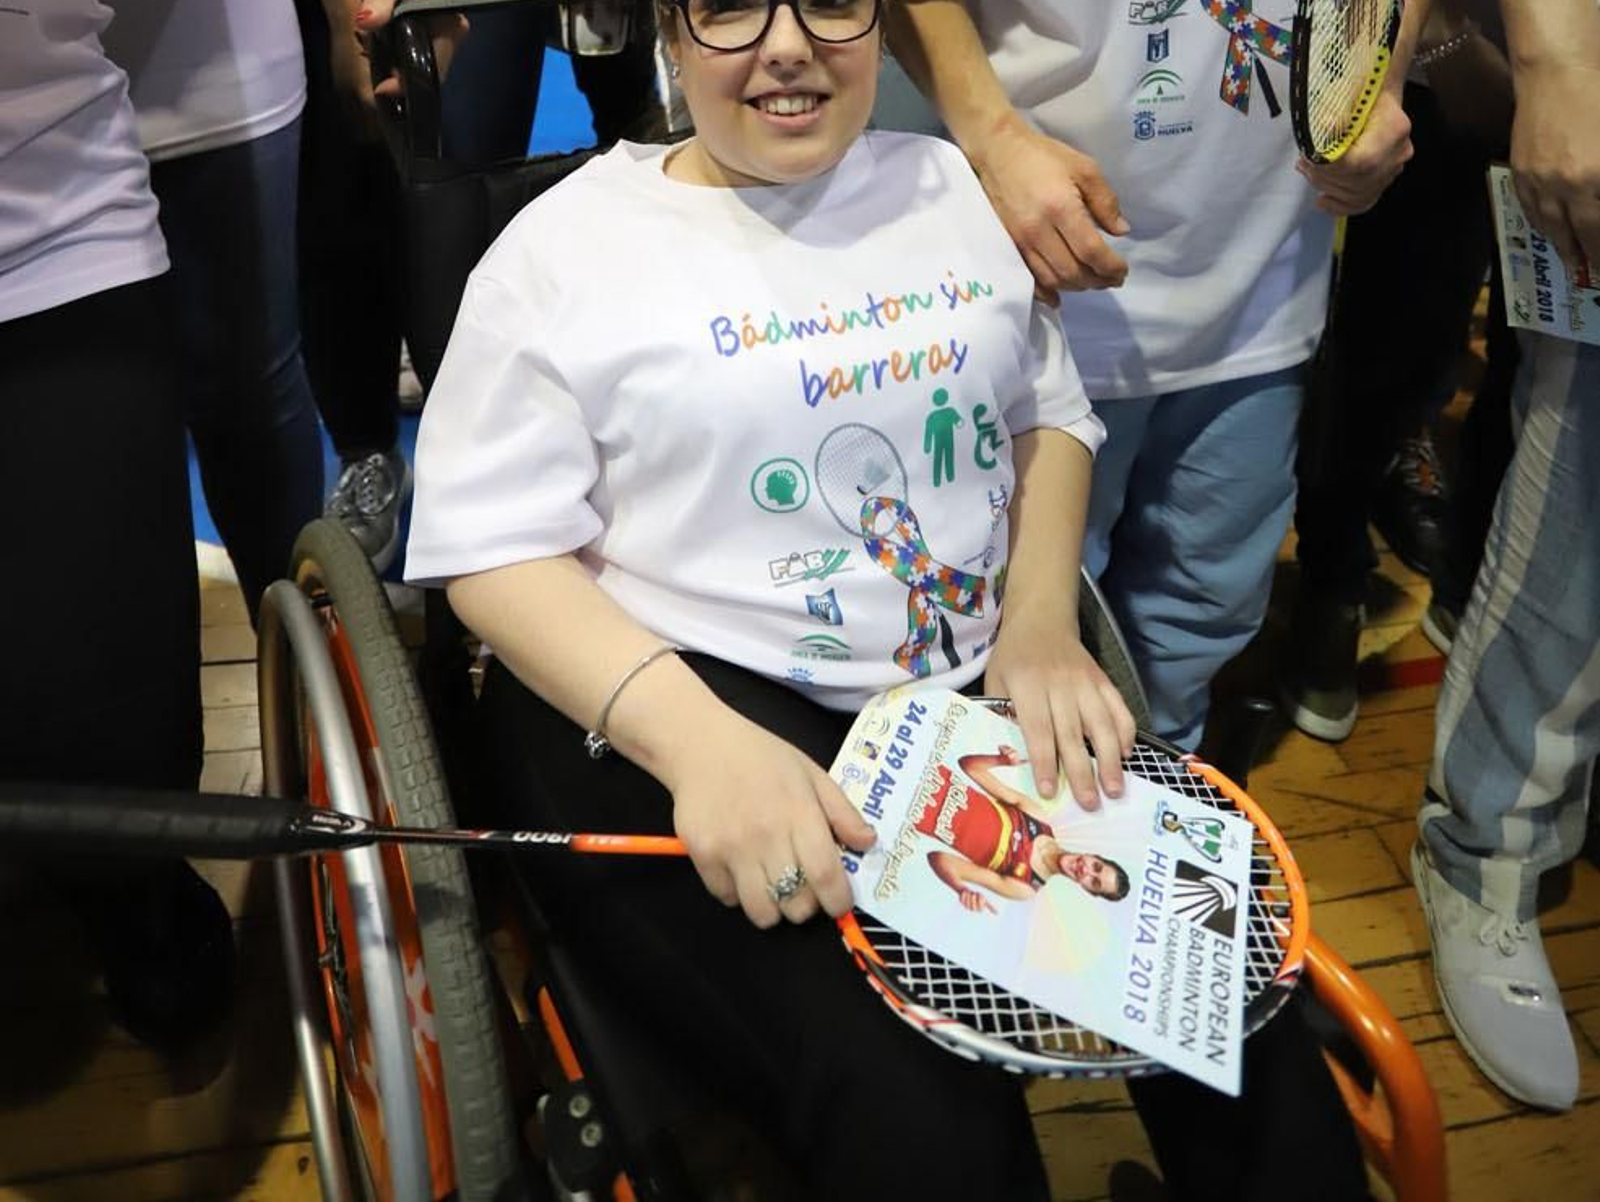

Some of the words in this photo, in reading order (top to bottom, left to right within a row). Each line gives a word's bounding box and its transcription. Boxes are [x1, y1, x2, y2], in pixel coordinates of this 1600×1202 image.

[709, 291, 933, 358] Bádminton
[940, 270, 993, 310] sin
[1536, 289, 1555, 323] 2018
[799, 338, 969, 408] barreras
[895, 724, 915, 746] al
[903, 700, 928, 726] 24
[884, 742, 909, 771] 29
[862, 768, 897, 821] Abril
[1135, 847, 1169, 946] HUELVA
[1123, 954, 1154, 1025] 2018
[1154, 918, 1182, 1039] CHAMPIONSHIPS
[1178, 927, 1206, 1052] BADMINTON
[1205, 937, 1234, 1066] EUROPEAN
